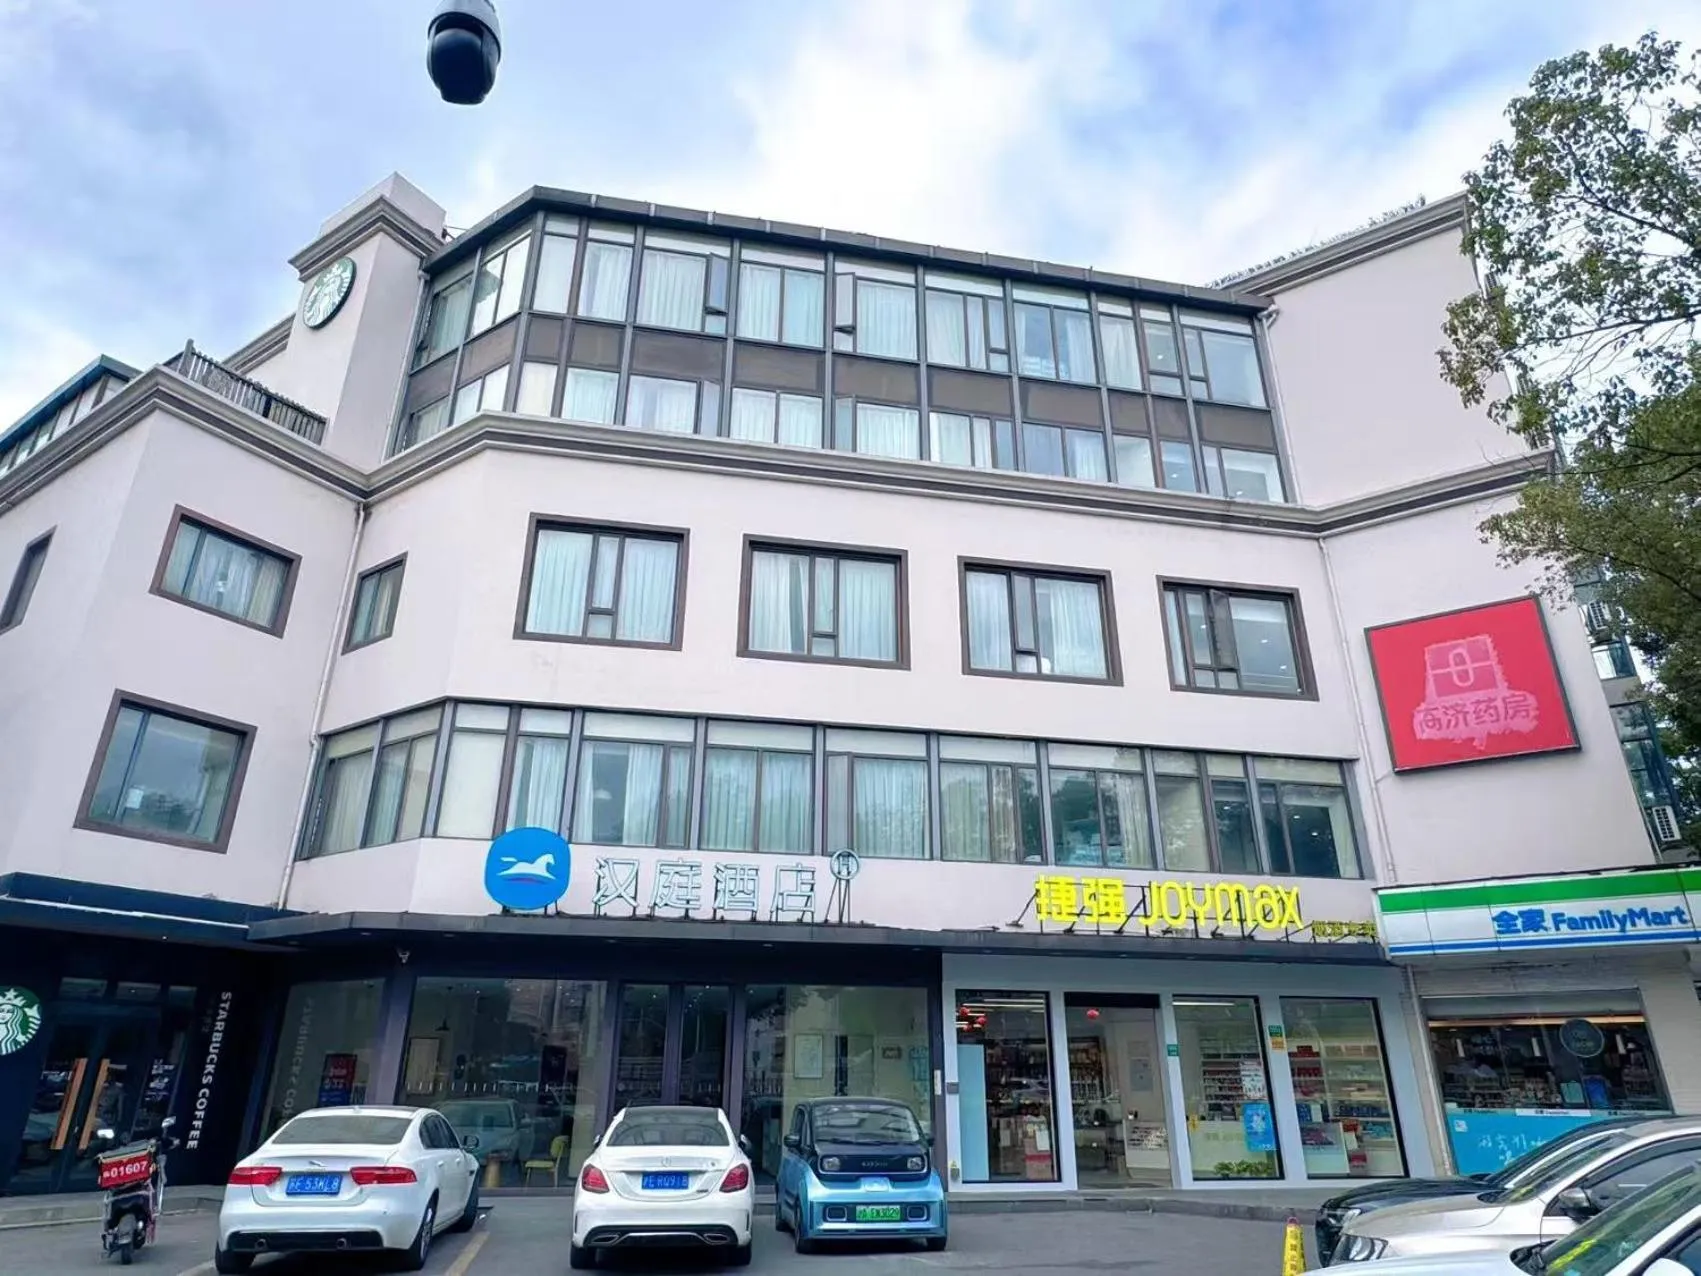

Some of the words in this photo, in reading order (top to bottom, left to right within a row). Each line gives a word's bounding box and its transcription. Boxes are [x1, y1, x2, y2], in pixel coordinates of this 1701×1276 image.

[592, 856, 818, 913] 汉庭酒店
[1035, 874, 1125, 924] 捷强
[1492, 908, 1547, 934] 全家
[1551, 906, 1688, 932] FamilyMart
[201, 991, 233, 1085] STARBUCKS
[186, 1087, 210, 1150] COFFEE
